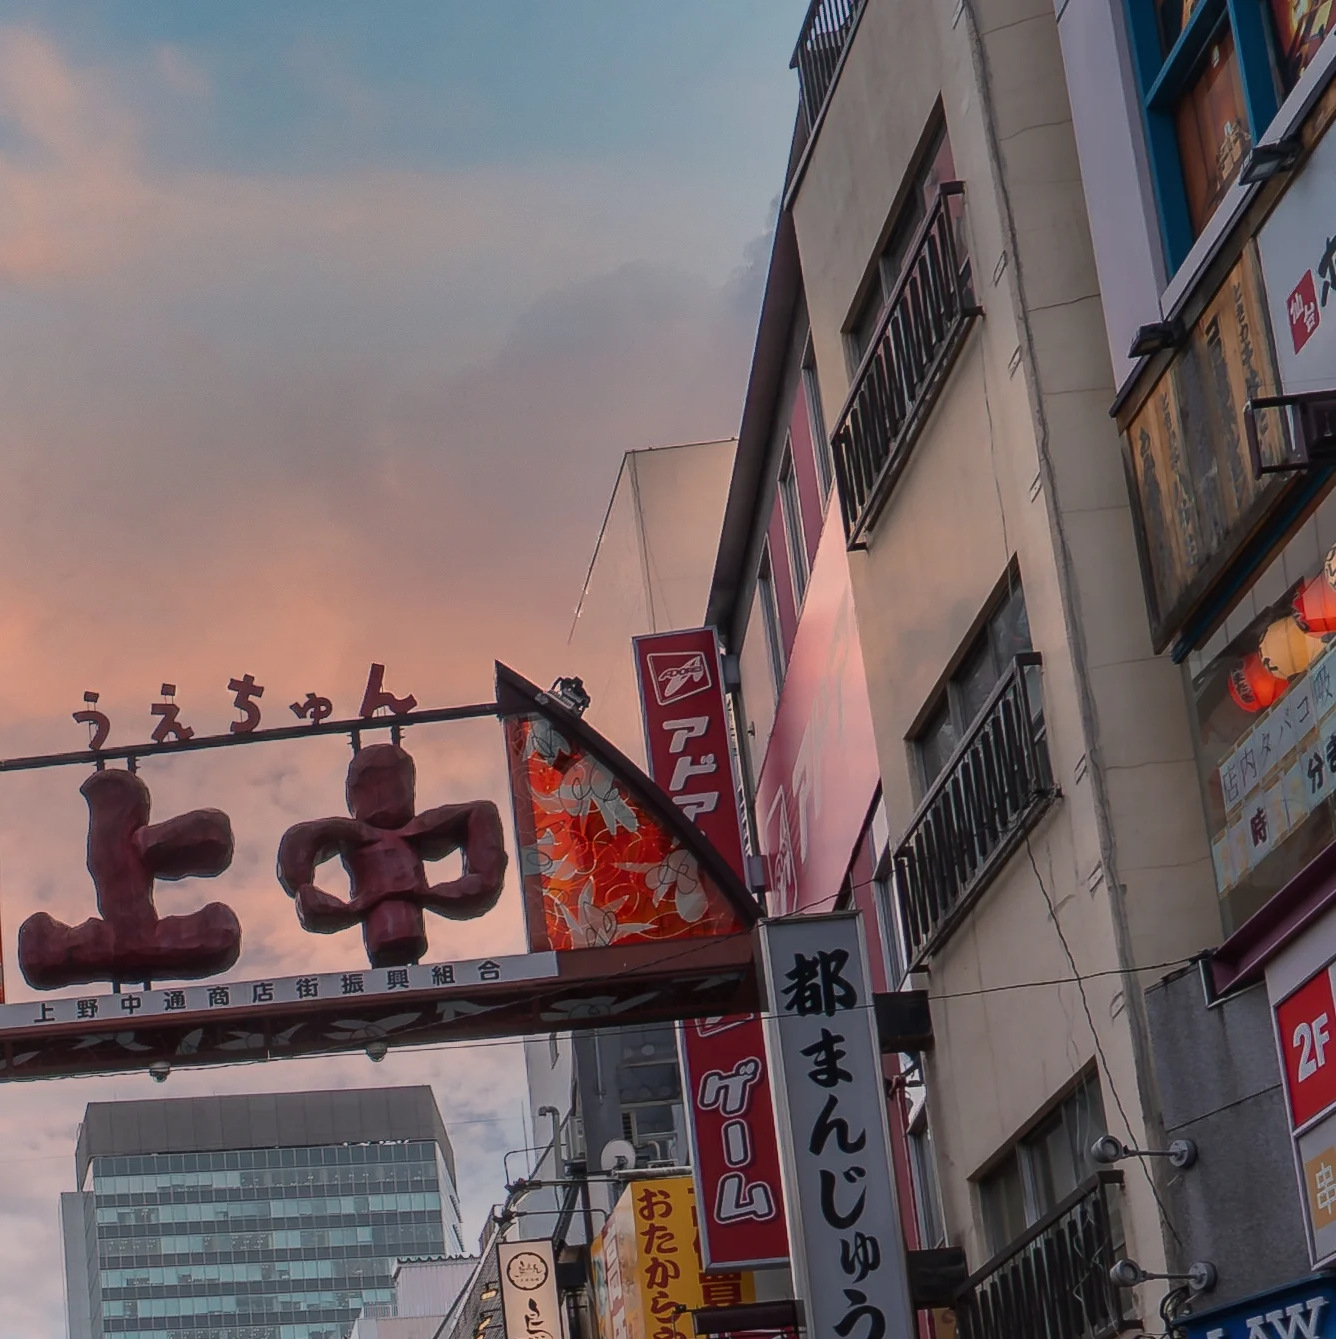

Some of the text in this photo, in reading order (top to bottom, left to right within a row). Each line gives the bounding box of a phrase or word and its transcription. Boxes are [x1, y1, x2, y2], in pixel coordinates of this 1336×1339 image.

[33, 959, 503, 1026] 上野中通商店街振興組合
[1292, 1012, 1331, 1083] 2F
[697, 1055, 777, 1225] ゲーム
